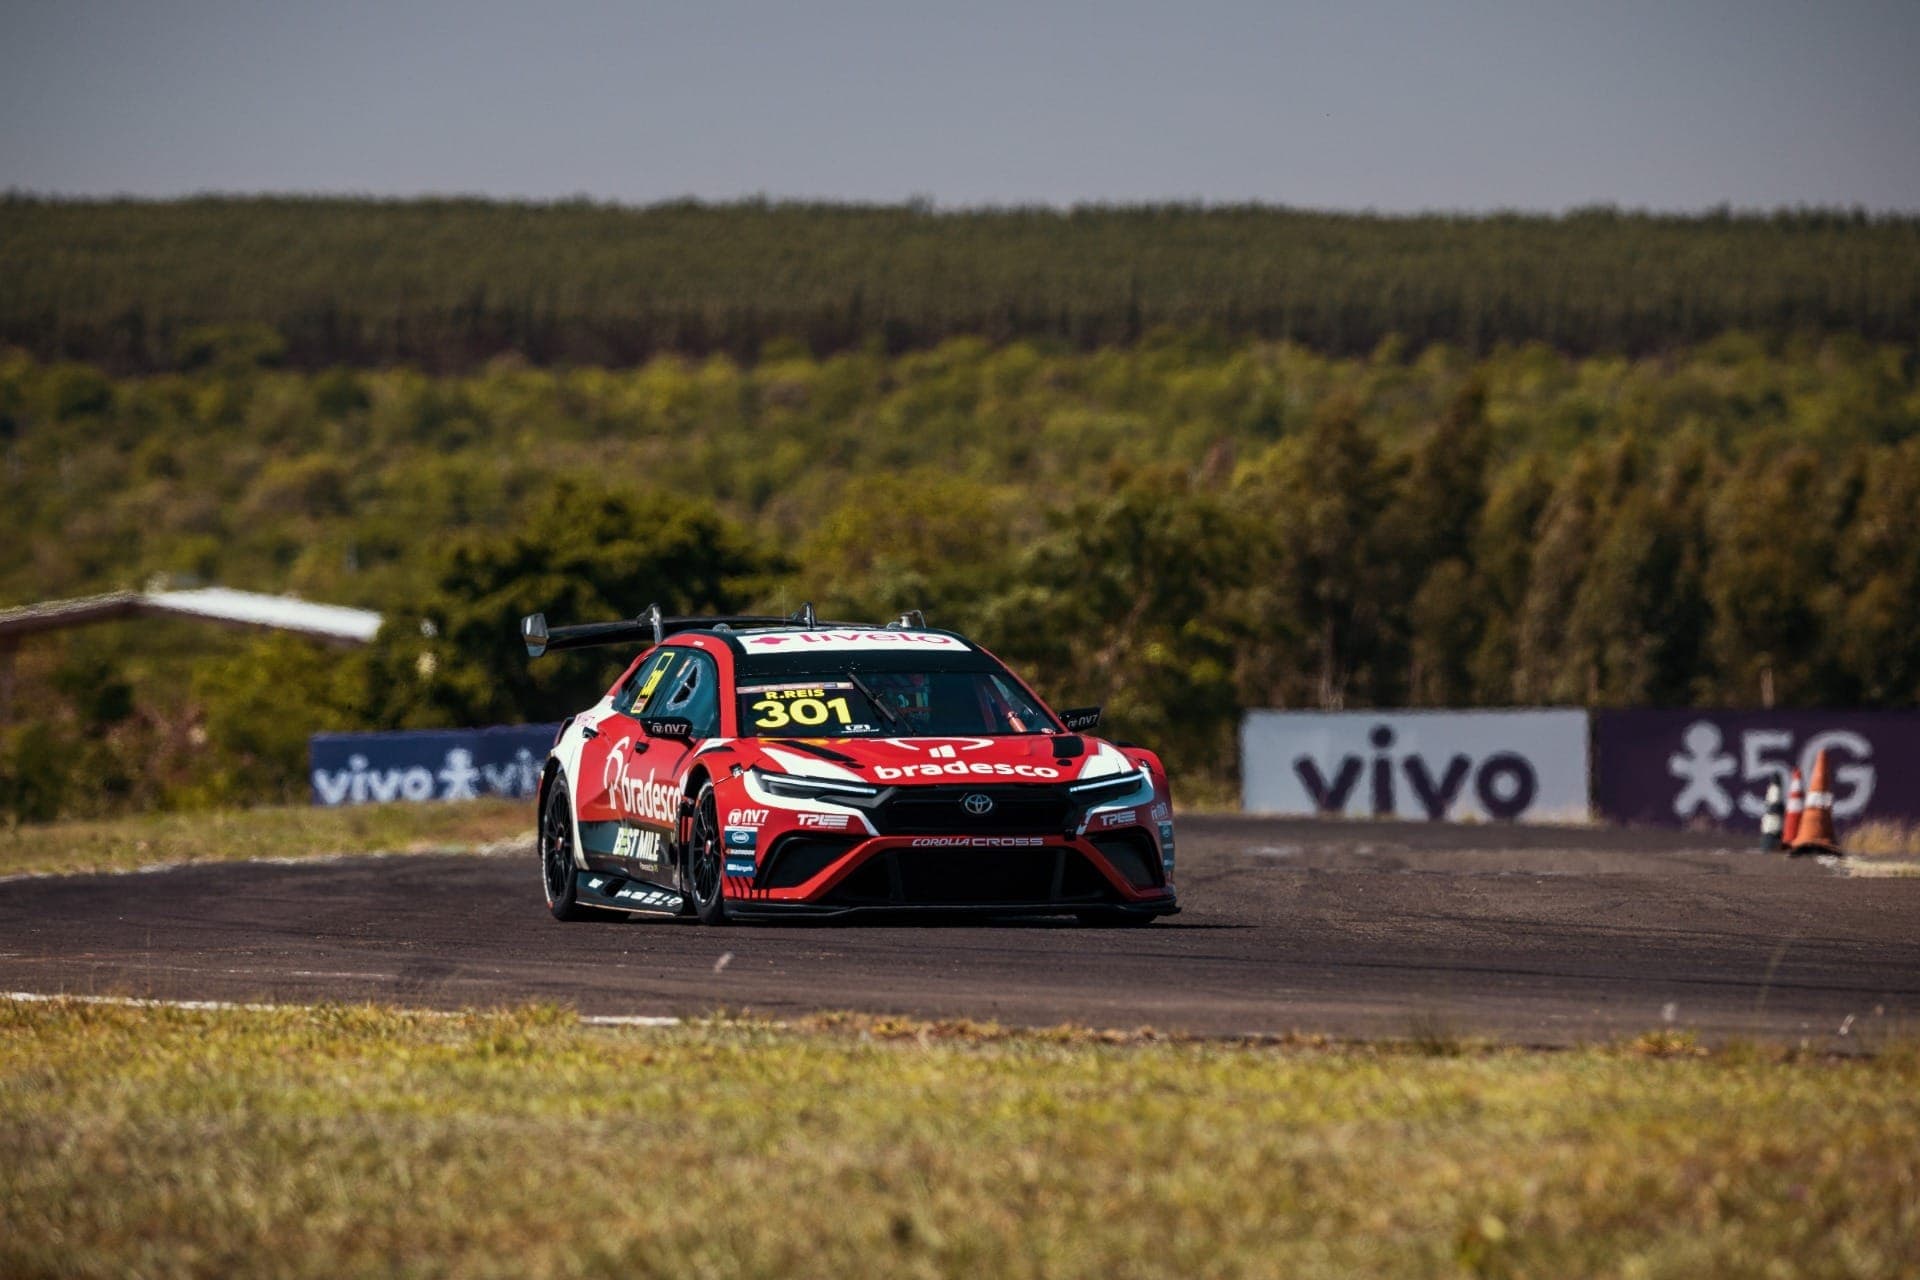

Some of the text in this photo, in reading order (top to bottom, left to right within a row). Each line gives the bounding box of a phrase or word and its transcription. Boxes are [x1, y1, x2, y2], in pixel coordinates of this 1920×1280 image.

[800, 631, 951, 645] livelo
[765, 688, 825, 700] R.REIS
[752, 697, 852, 728] 301
[313, 742, 435, 806] vivo
[482, 747, 544, 798] vi
[874, 760, 1059, 779] bradesco
[1293, 723, 1538, 820] vivo
[1738, 729, 1877, 820] 5G
[612, 827, 661, 862] BEST MILE
[912, 837, 1044, 847] COROLLA CROSS
